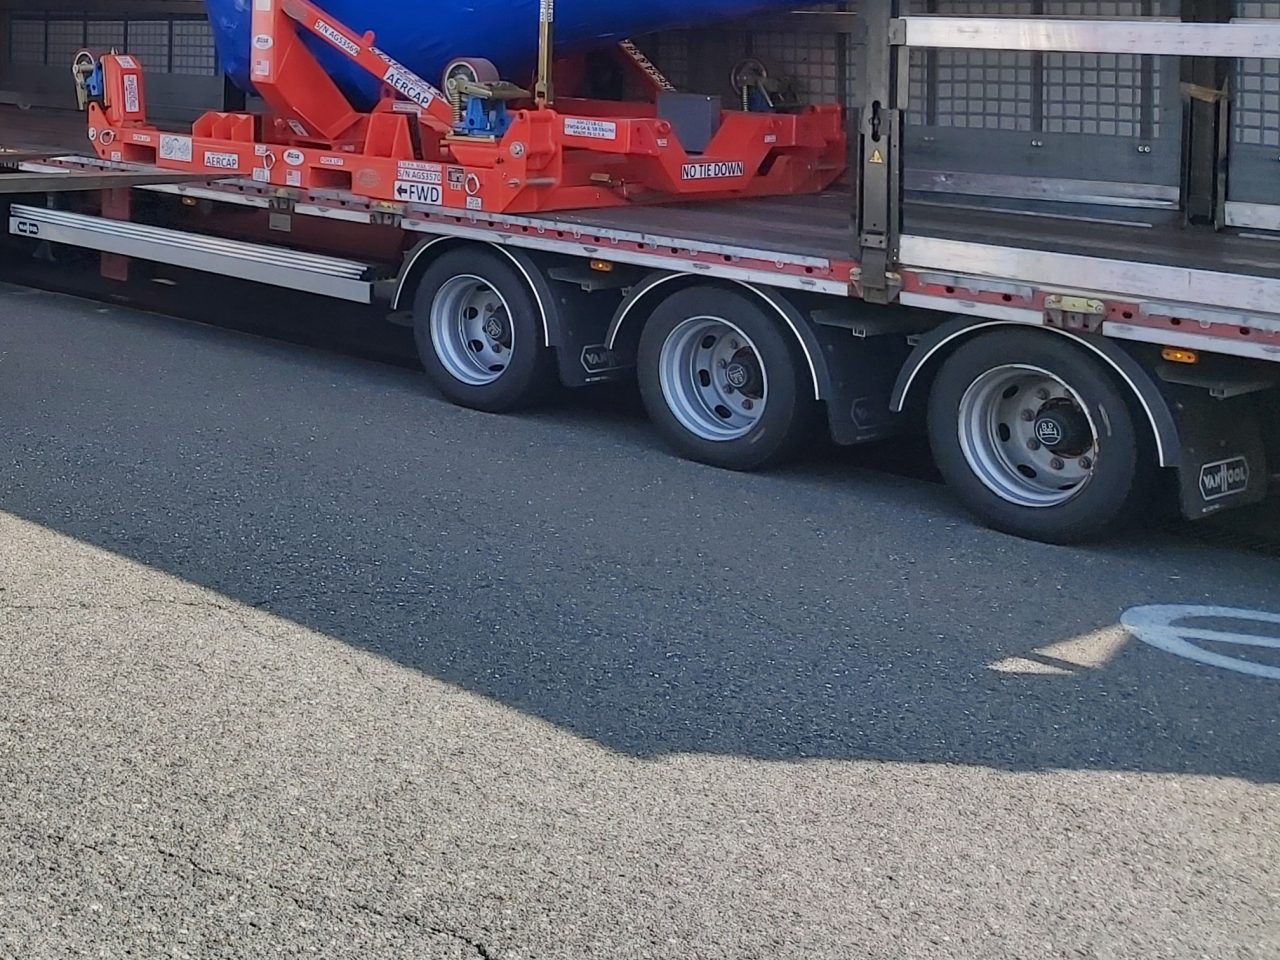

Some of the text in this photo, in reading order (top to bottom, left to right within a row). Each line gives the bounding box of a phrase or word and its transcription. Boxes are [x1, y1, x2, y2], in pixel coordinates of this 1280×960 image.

[386, 73, 429, 106] AERCAP
[206, 156, 237, 167] AERCAP
[398, 168, 410, 178] S/N
[682, 162, 742, 178] NO TIE DOWN
[409, 184, 440, 203] FWD
